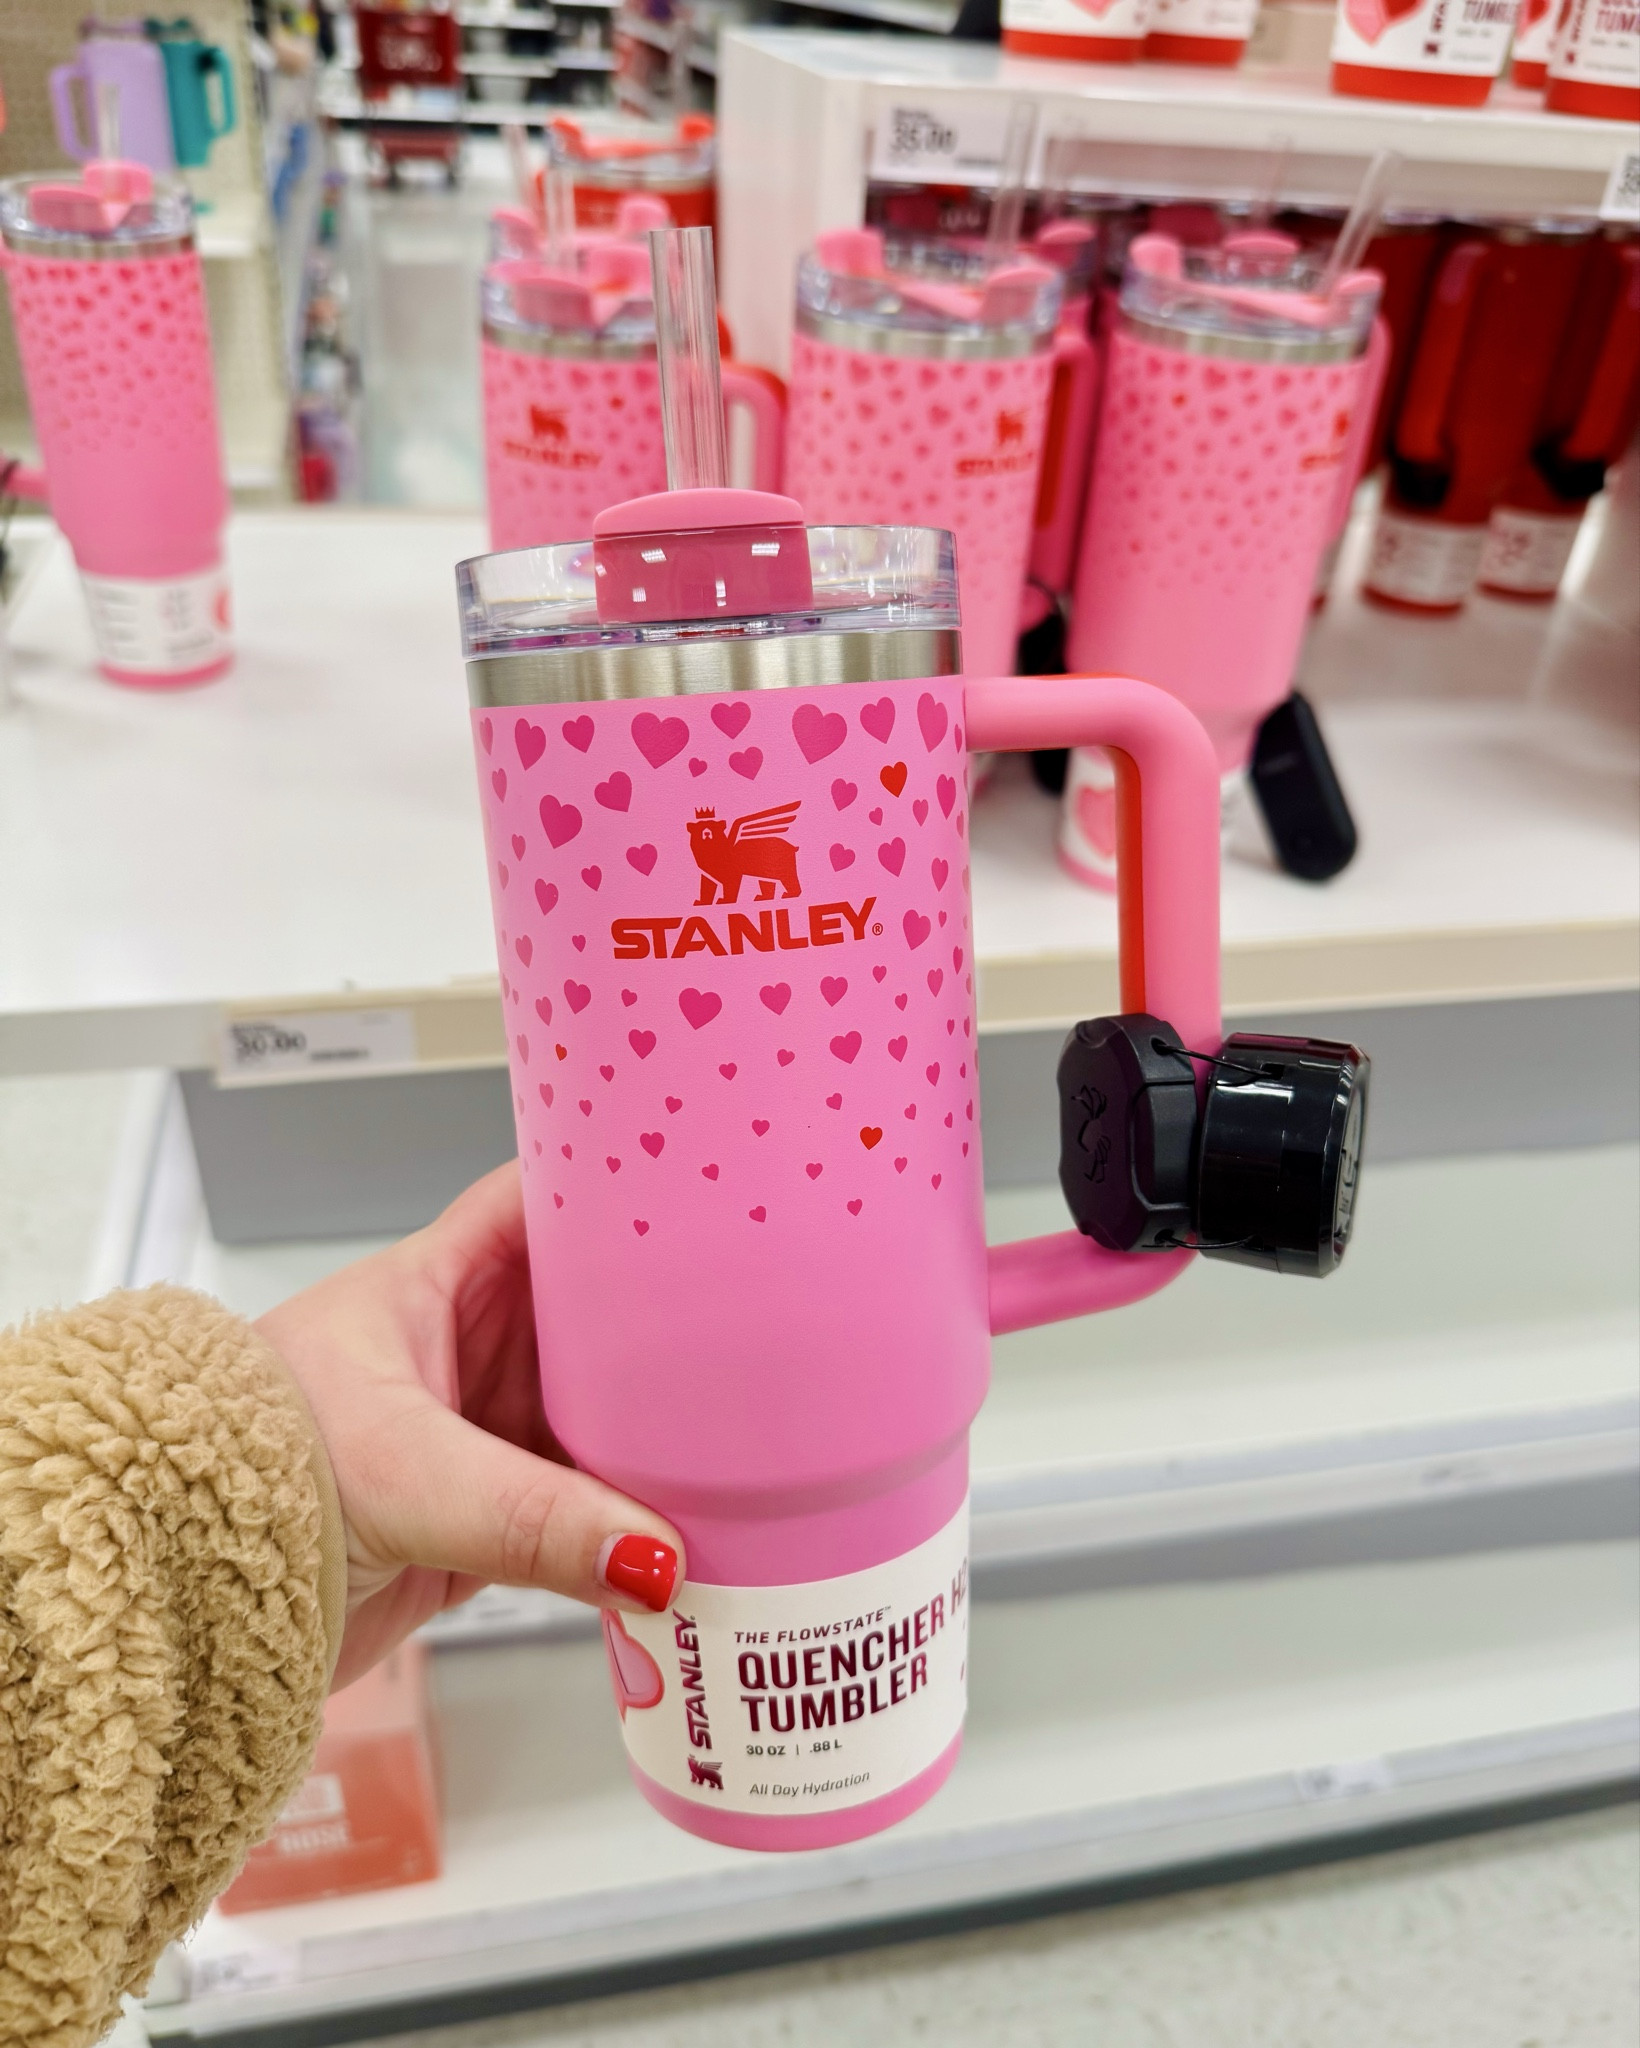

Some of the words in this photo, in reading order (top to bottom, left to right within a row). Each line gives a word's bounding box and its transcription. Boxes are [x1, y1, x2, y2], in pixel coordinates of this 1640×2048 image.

[734, 1631, 770, 1644] THE
[738, 1592, 944, 1690] QUENCHER
[740, 1651, 927, 1732] TUMBLER
[746, 1744, 764, 1756] 30
[767, 1745, 786, 1756] OZ
[809, 1740, 831, 1753] .88
[834, 1738, 842, 1749] L
[750, 1783, 768, 1795] All
[772, 1784, 799, 1798] Day
[803, 1771, 870, 1795] Hydration
